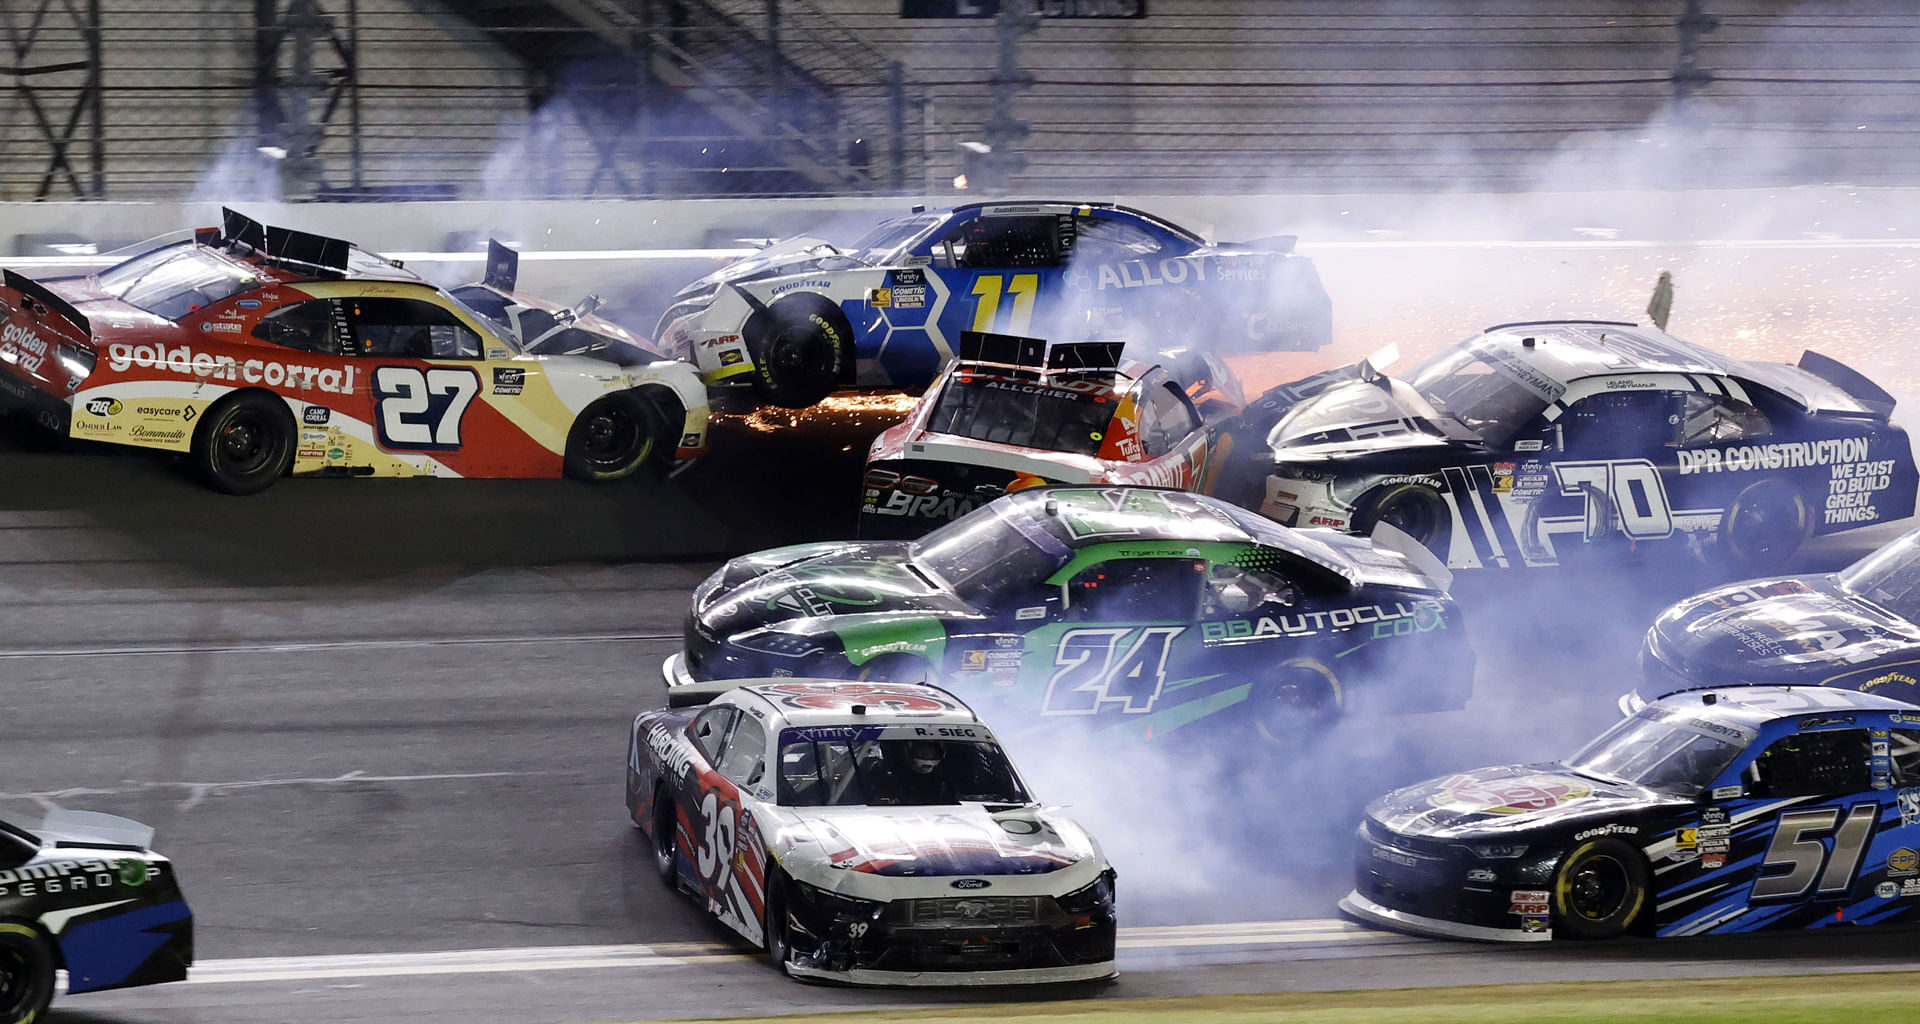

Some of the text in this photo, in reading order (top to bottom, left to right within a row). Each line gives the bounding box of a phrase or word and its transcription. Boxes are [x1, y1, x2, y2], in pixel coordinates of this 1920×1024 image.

[1097, 258, 1206, 290] ALLOY
[1217, 266, 1265, 281] Services
[771, 279, 831, 295] GOODYEAR
[970, 273, 1038, 337] 11
[212, 322, 242, 332] state
[1, 323, 48, 357] golden
[708, 334, 739, 348] ARP
[108, 342, 243, 384] golden
[242, 358, 355, 395] corral
[985, 380, 1080, 400] ALLGAIER
[136, 406, 181, 416] easycare
[375, 365, 481, 445] 27
[129, 425, 186, 439] Bommarito
[1677, 436, 1869, 475] DPR CONSTRUCTION
[1831, 460, 1895, 480] WE EXIST
[1381, 474, 1443, 489] GOODYEAR
[1828, 475, 1890, 494] TO BUILD
[1825, 492, 1872, 509] GREAT
[1309, 516, 1345, 527] ARP
[1824, 506, 1880, 524] THINGS.
[861, 641, 928, 657] GOODYEAR
[1041, 626, 1188, 716] 24
[1859, 671, 1918, 692] GOODYEAR
[916, 726, 977, 738] R. SIEG
[647, 722, 697, 779] HARDING
[1574, 824, 1640, 841] GOODYEAR
[697, 793, 735, 891] 39
[1750, 803, 1878, 899] 51
[958, 880, 984, 889] Ford
[1510, 904, 1549, 913] ARP
[849, 922, 869, 938] 39
